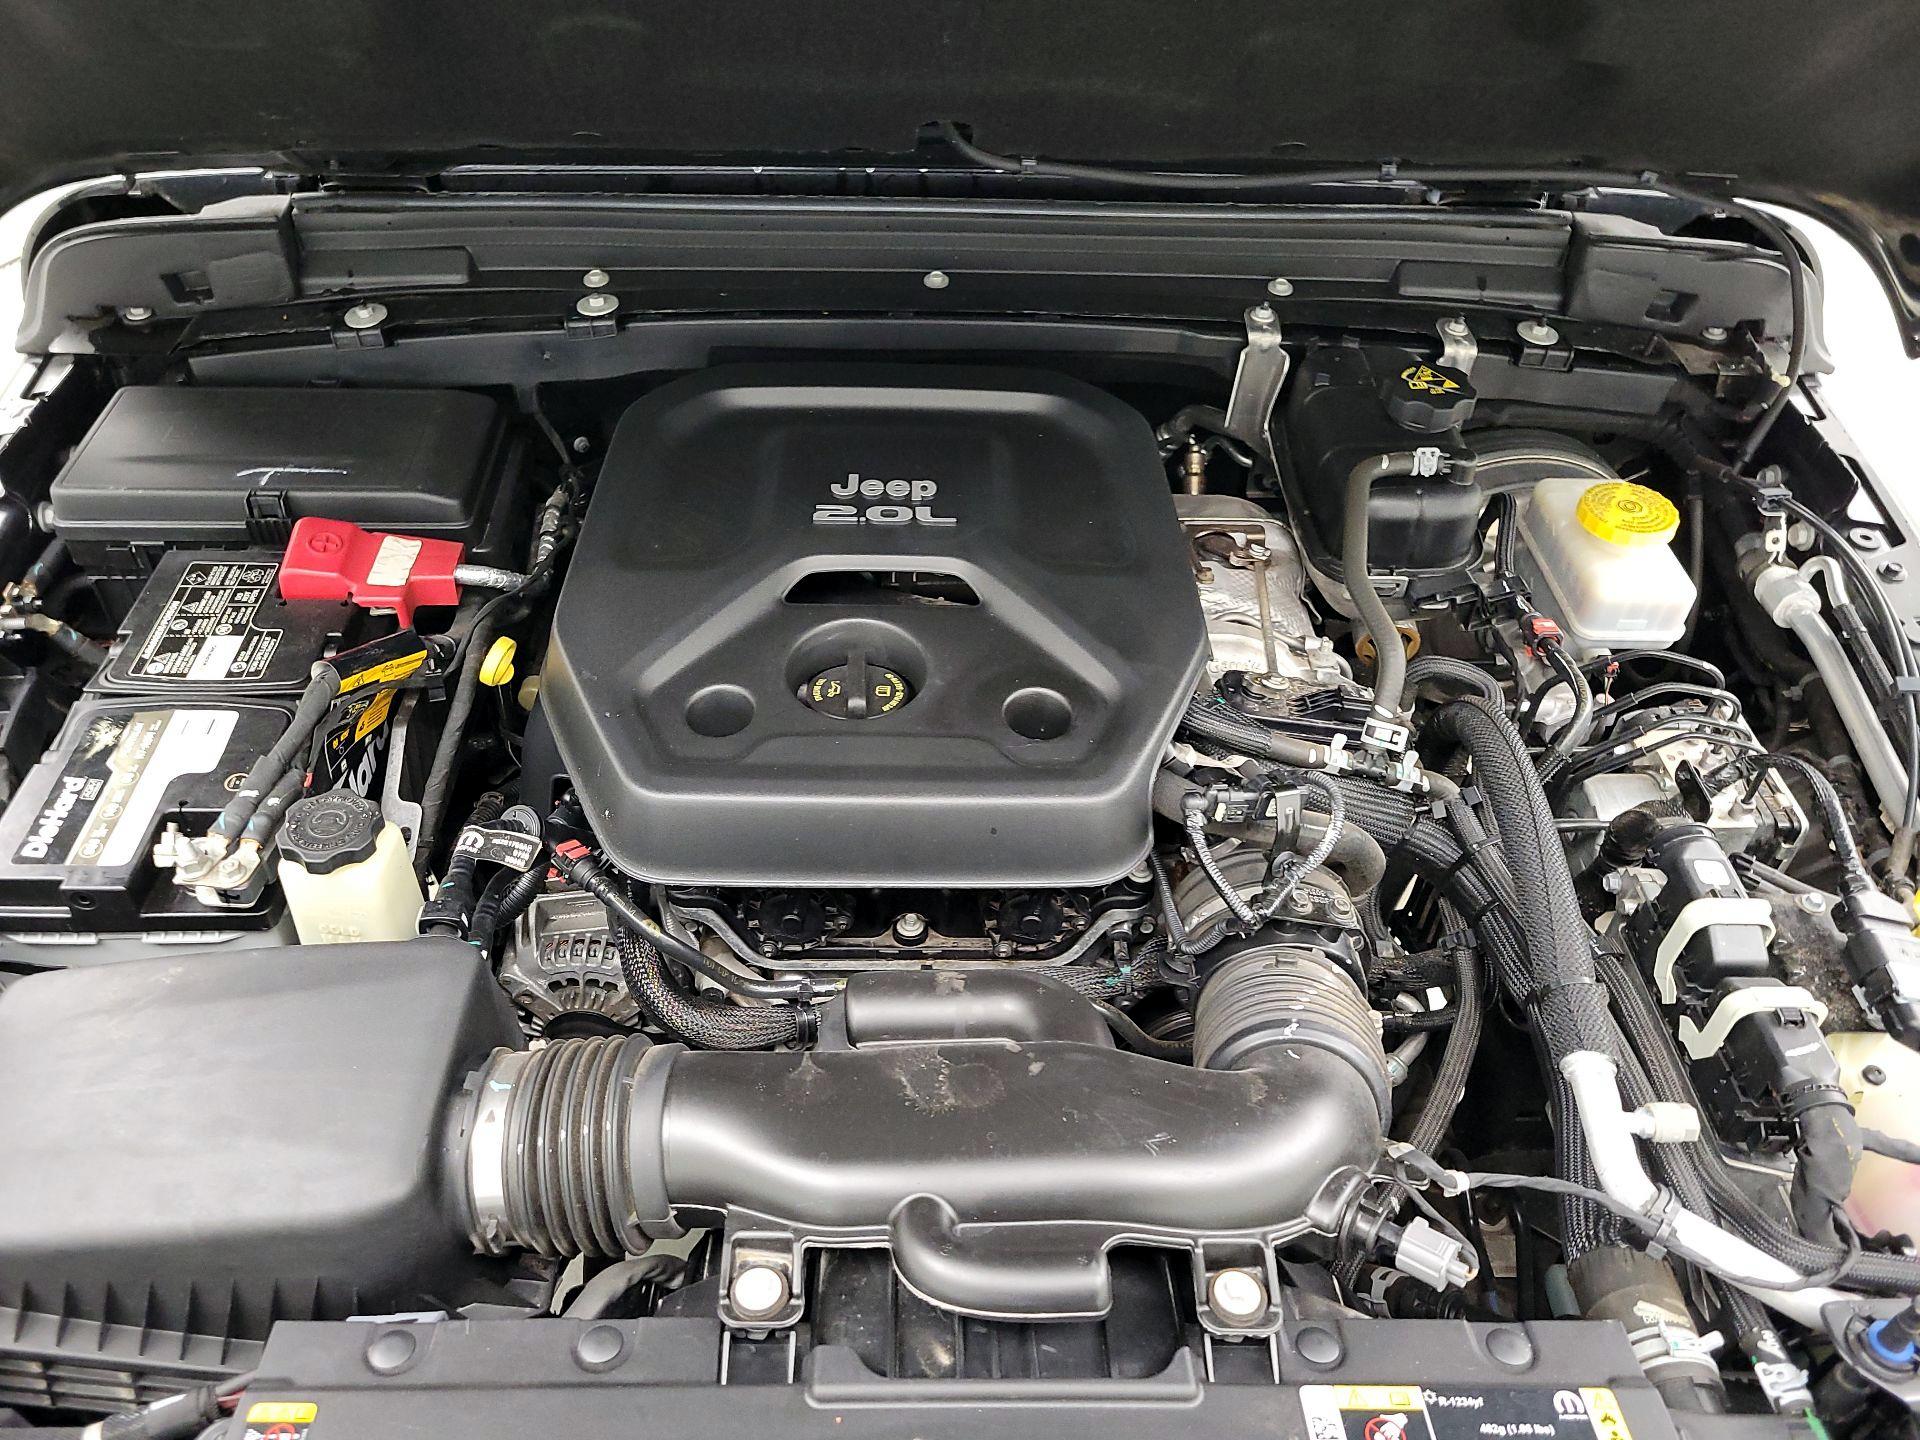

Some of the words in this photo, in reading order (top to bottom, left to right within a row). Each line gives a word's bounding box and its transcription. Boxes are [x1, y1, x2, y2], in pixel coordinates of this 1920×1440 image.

[830, 473, 938, 501] Jeep
[813, 505, 958, 525] 2.0L
[20, 776, 86, 858] DieHard
